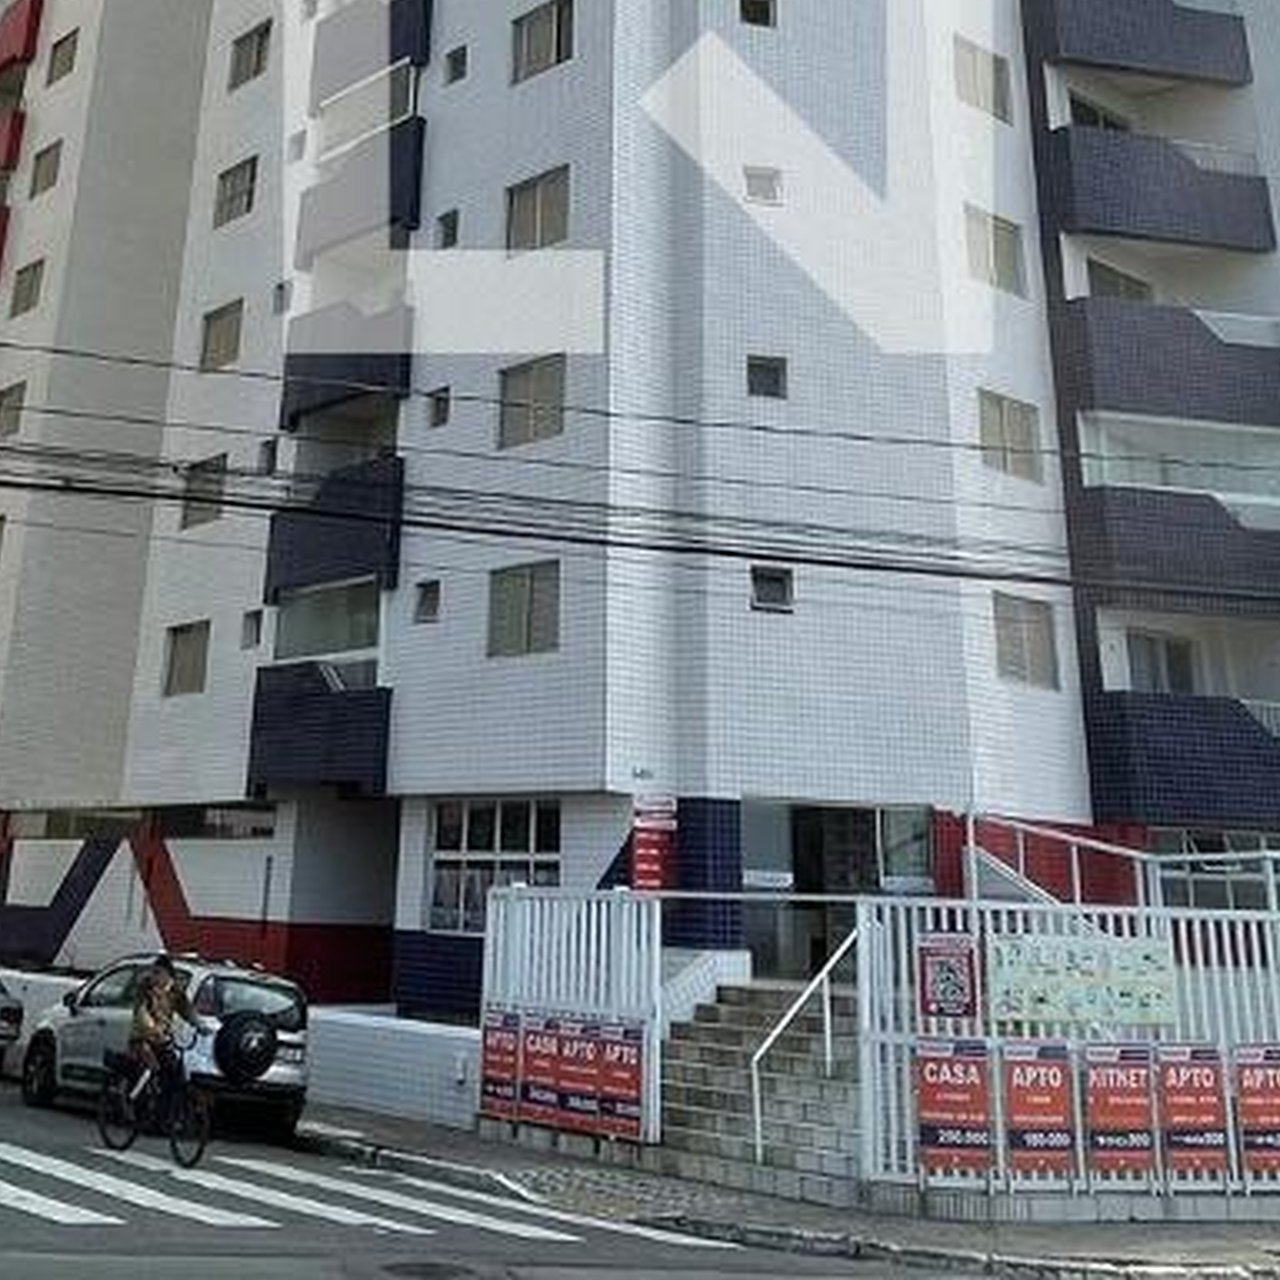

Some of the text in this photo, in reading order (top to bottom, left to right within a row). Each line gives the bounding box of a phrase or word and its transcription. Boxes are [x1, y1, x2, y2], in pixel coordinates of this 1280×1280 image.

[605, 1043, 638, 1066] APTO
[923, 1062, 981, 1086] CASA
[1012, 1066, 1063, 1088] APTO
[1088, 1067, 1147, 1089] KITNET
[1165, 1066, 1216, 1088] APTO
